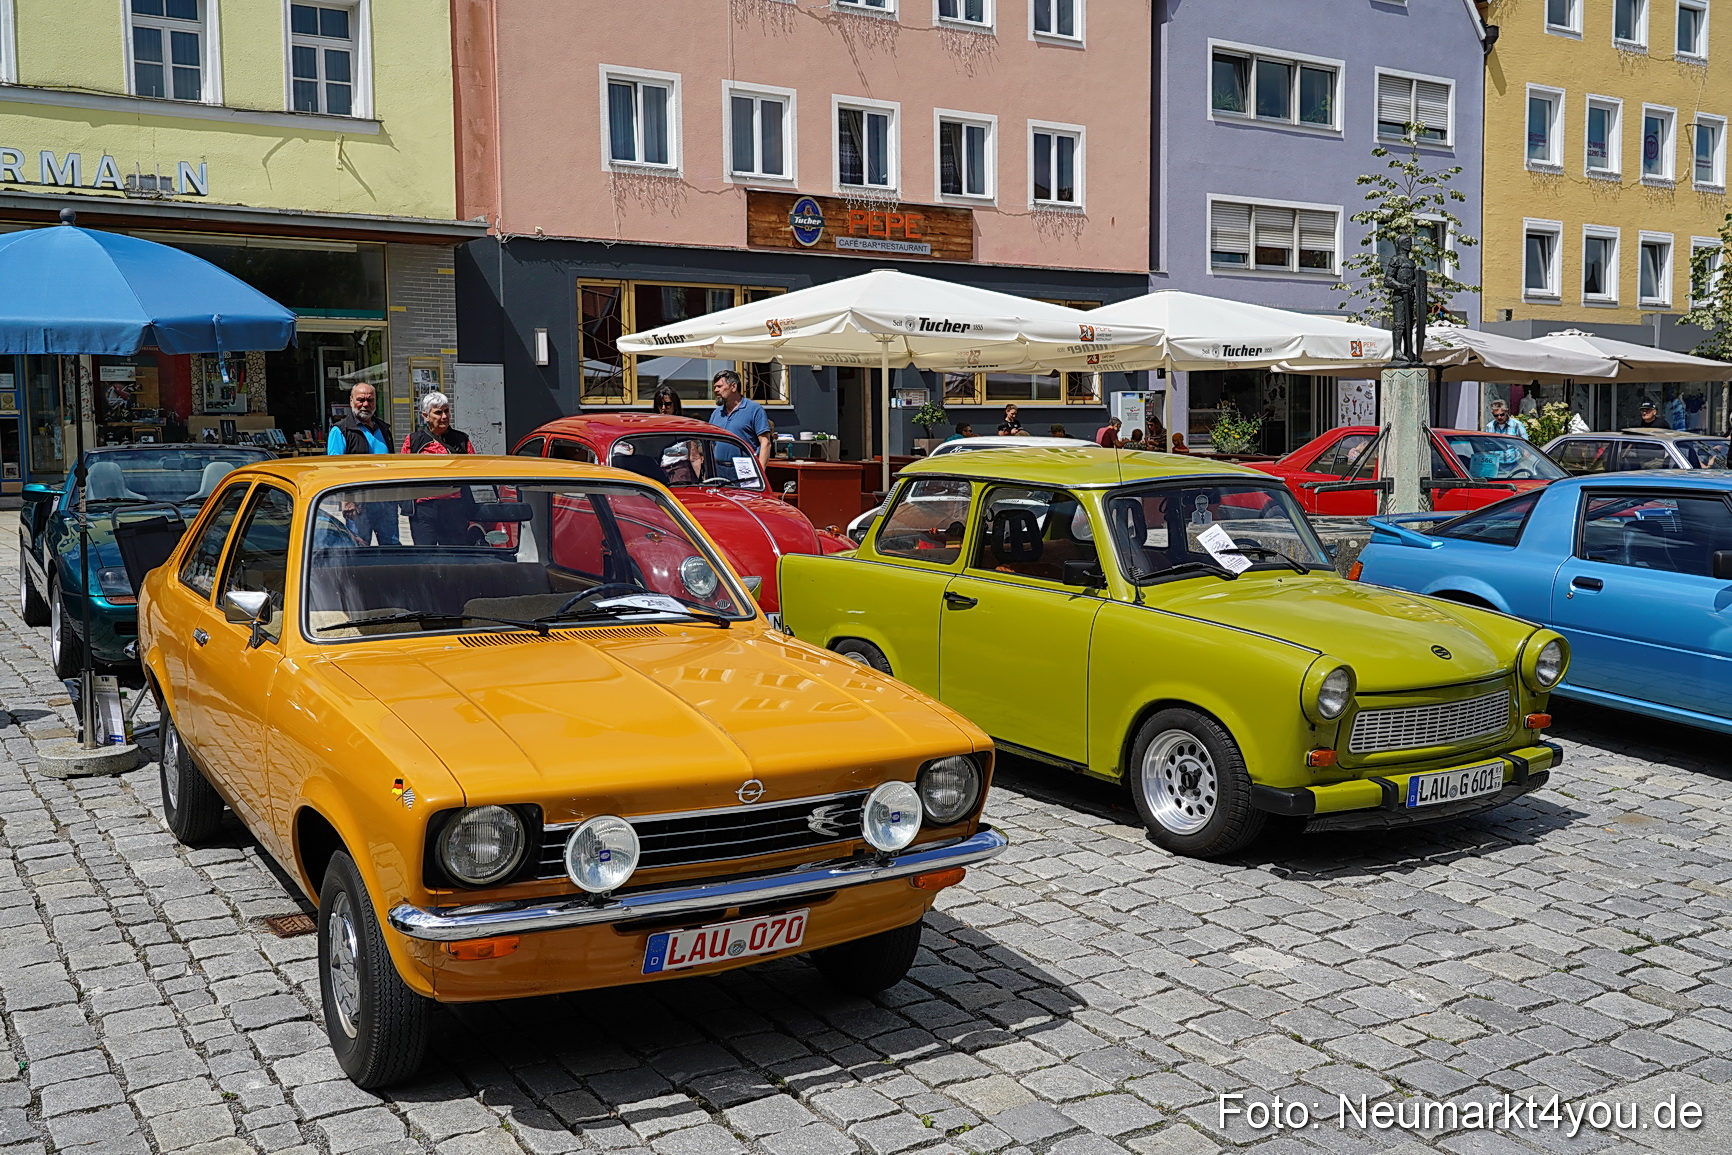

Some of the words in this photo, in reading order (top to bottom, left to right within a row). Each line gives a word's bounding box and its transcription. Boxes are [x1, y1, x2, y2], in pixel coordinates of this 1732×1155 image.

[794, 216, 822, 226] Tucher
[848, 209, 922, 239] PEPE
[918, 316, 971, 334] Tucher
[651, 332, 687, 346] Tucher
[1222, 344, 1263, 357] Tucher
[1419, 775, 1451, 802] LAU
[650, 956, 659, 966] D
[667, 928, 731, 966] LAU
[748, 915, 804, 951] 070
